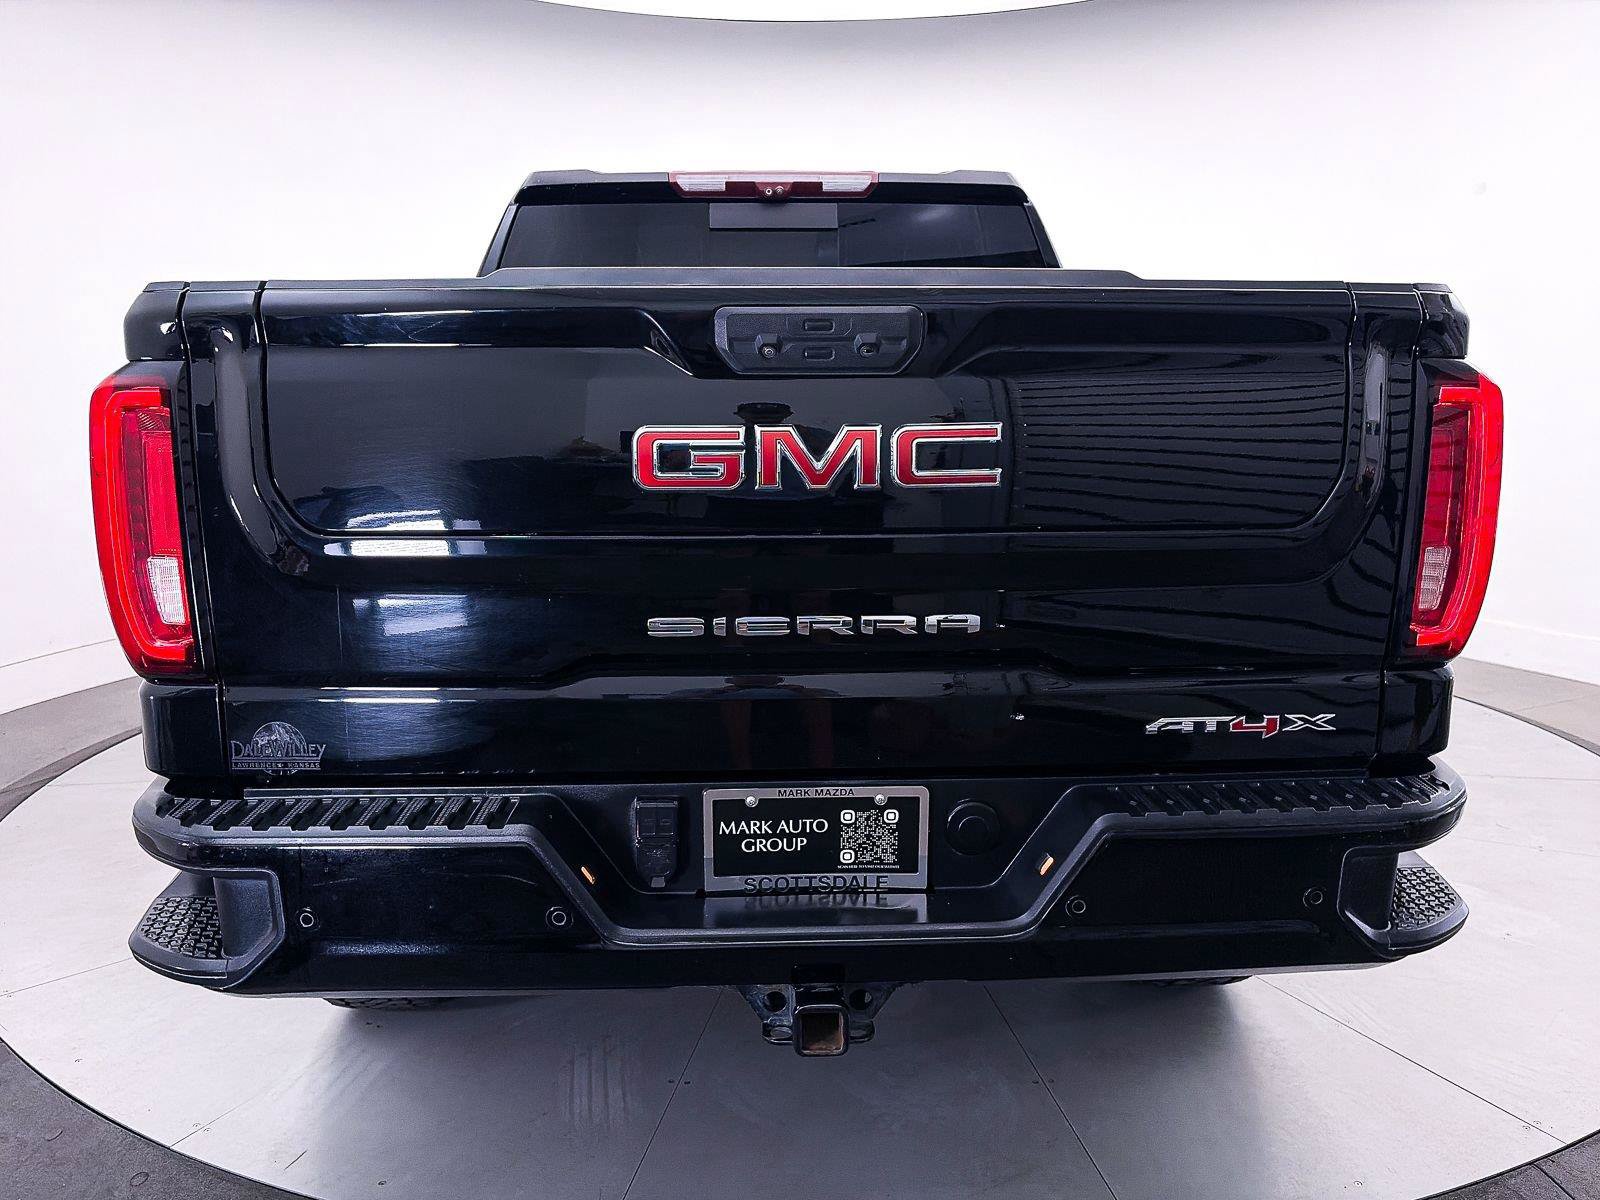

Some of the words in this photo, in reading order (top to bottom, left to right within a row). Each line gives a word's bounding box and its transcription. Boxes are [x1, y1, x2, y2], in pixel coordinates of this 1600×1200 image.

[632, 423, 1003, 491] GMC
[647, 614, 981, 637] SIERRA
[1145, 713, 1337, 739] AT4X
[270, 742, 326, 759] WILLEY
[777, 788, 811, 798] MARK
[814, 788, 855, 797] MAZDA
[719, 820, 773, 835] MARK
[776, 818, 829, 834] AUTO
[741, 837, 808, 853] GROUP
[744, 874, 889, 893] SCOTTSDALE
